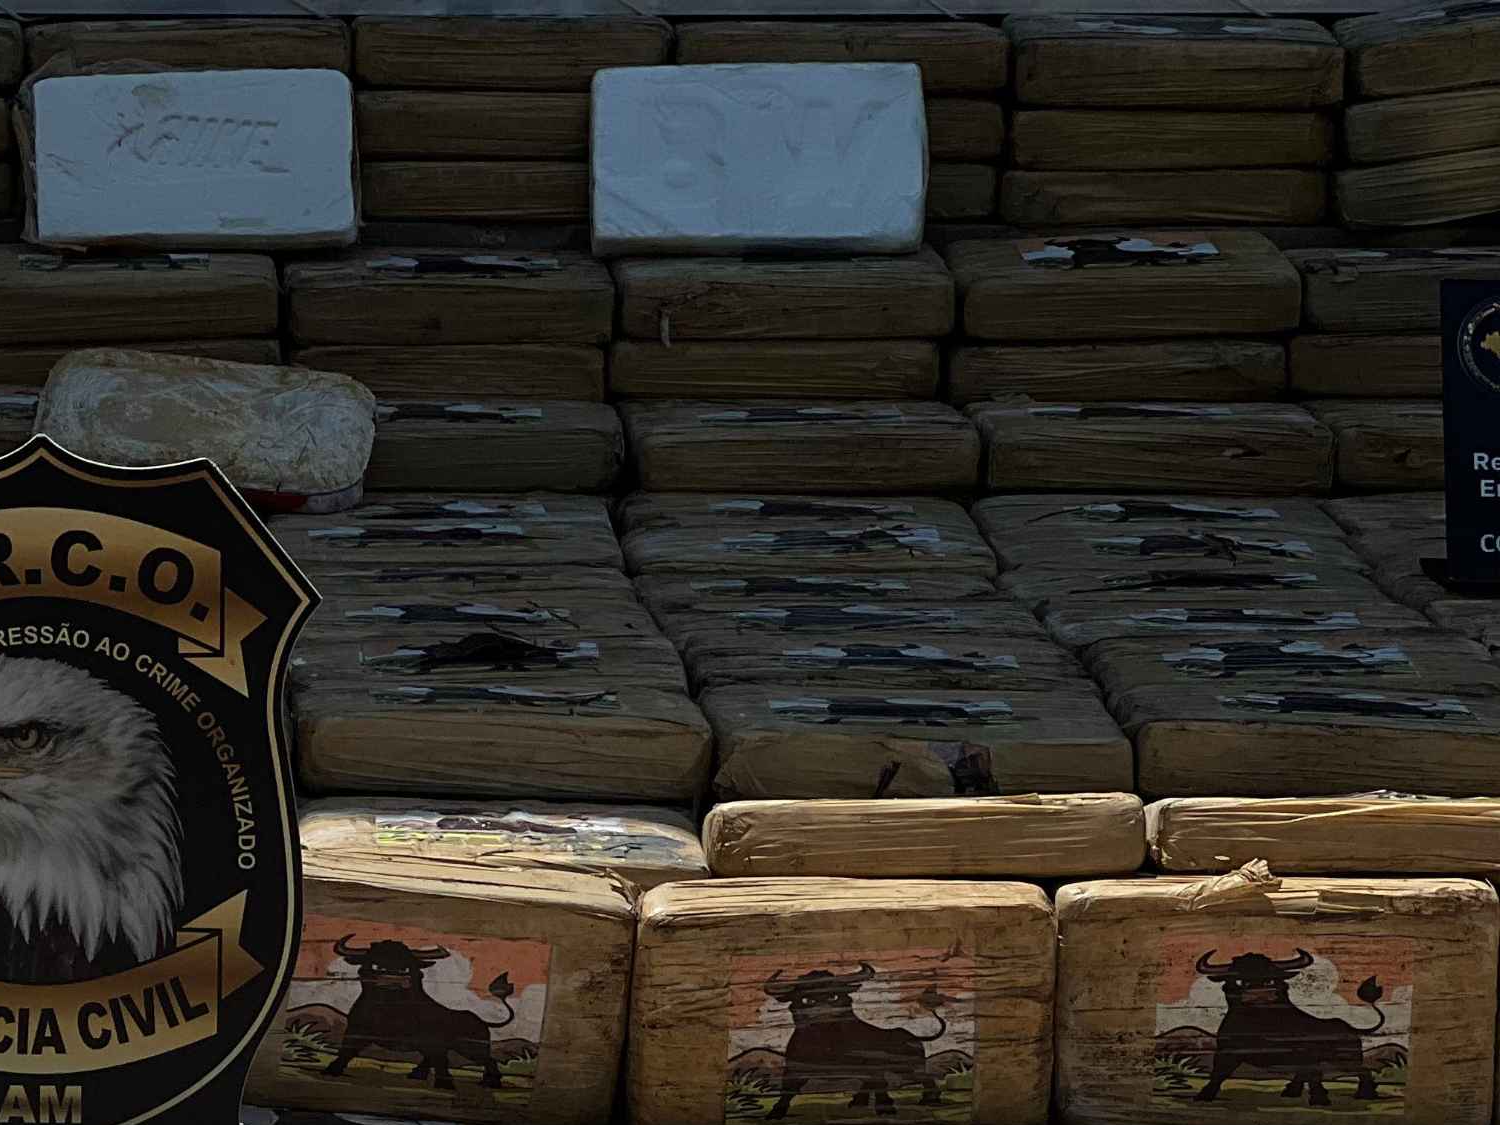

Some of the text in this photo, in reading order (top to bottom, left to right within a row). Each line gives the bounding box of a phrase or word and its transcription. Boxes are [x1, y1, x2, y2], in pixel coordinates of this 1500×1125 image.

[94, 636, 131, 662] AO
[135, 654, 201, 713] CRIME
[196, 711, 256, 870] ORGANIZADO
[76, 976, 211, 1050] CIVIL
